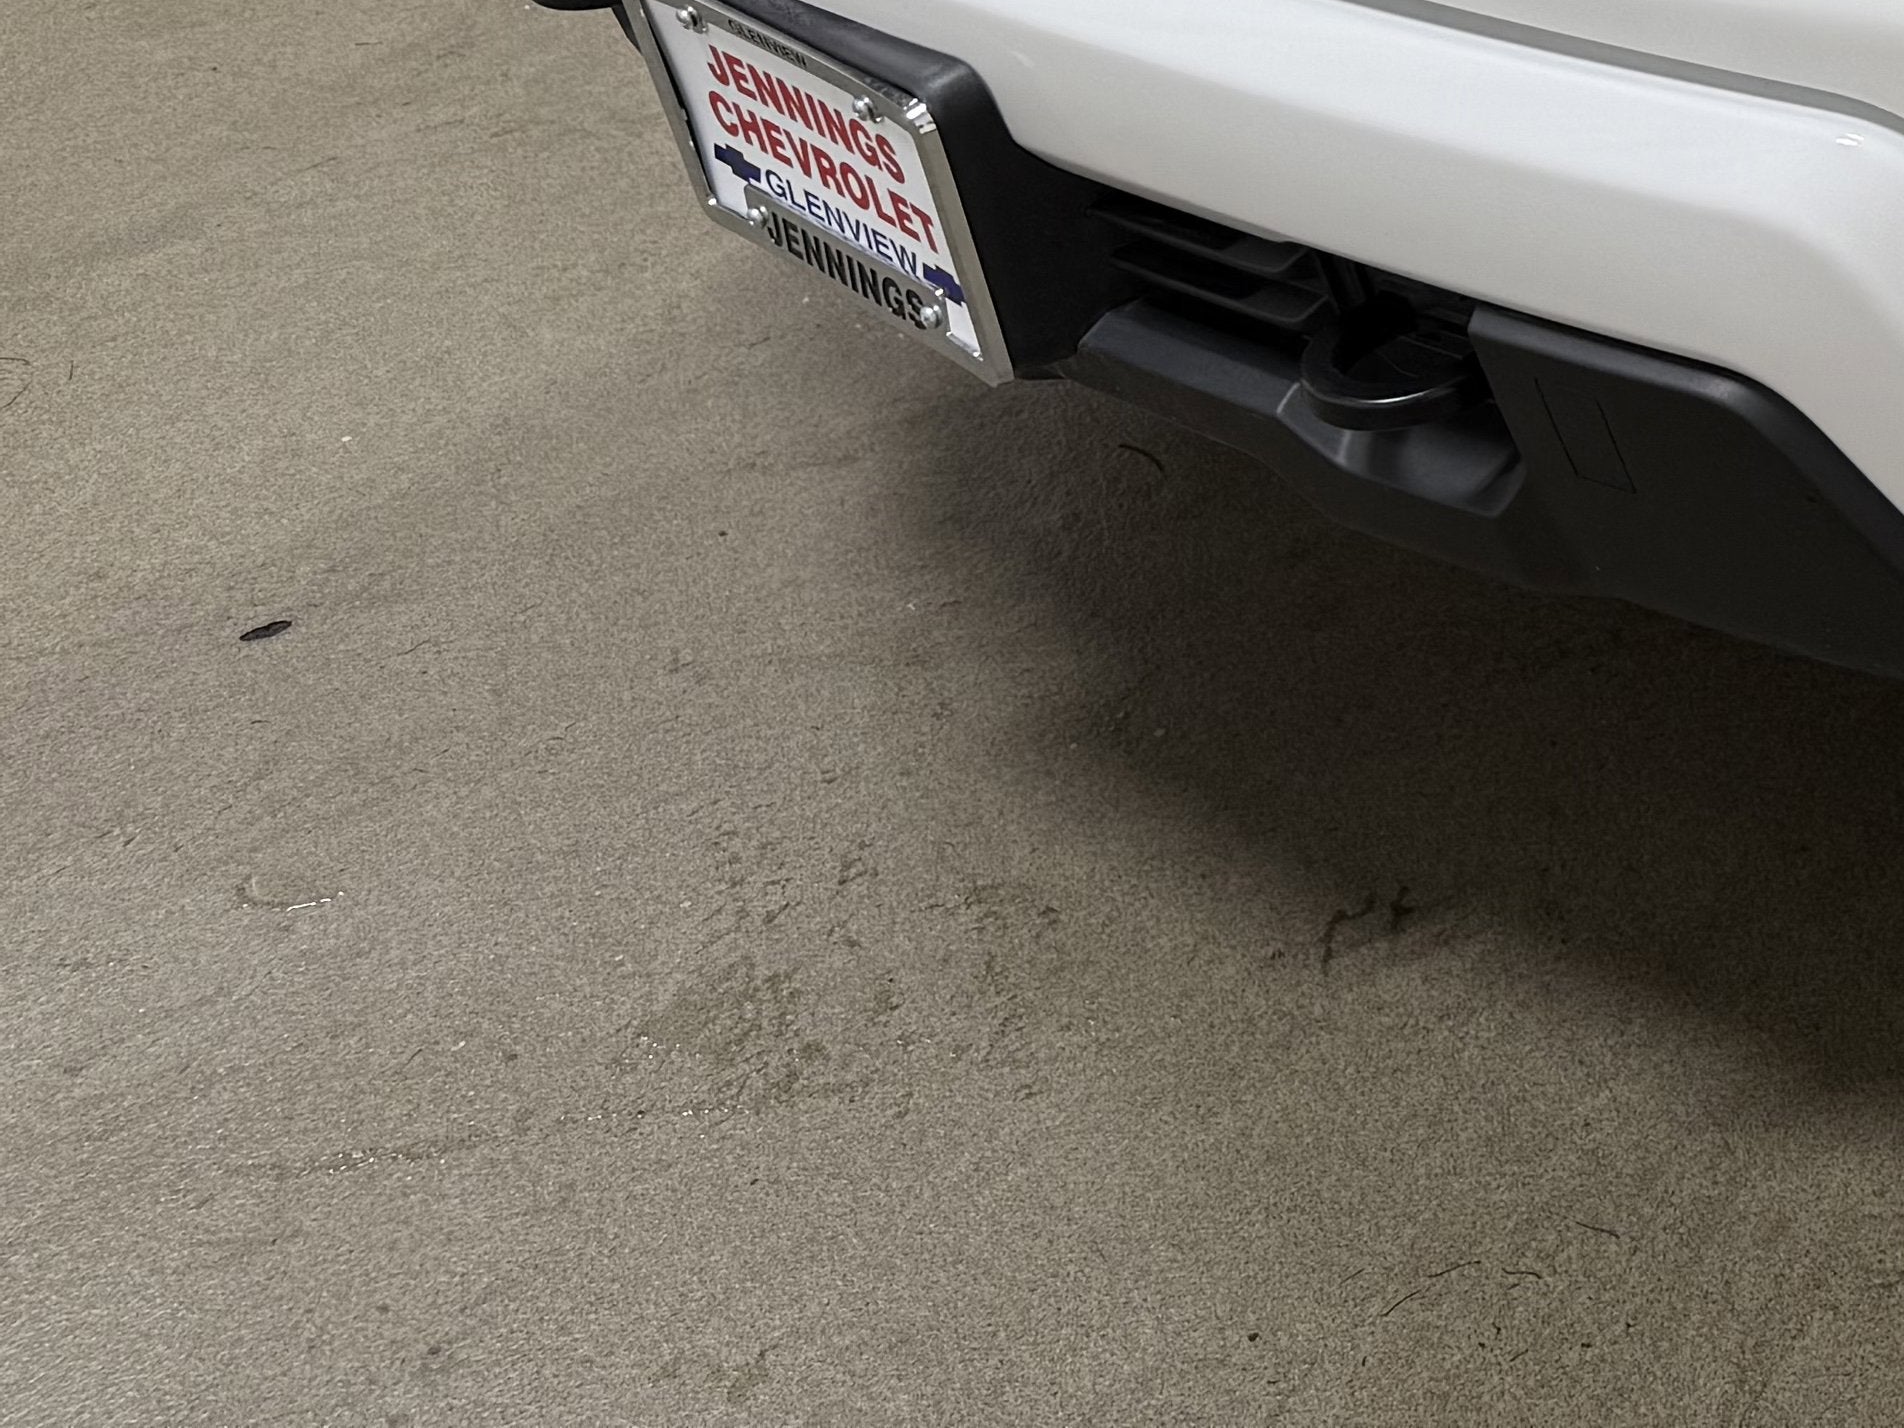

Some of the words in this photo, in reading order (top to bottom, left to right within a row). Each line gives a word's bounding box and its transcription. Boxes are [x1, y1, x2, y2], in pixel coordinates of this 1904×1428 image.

[708, 45, 905, 184] JENNINGS
[708, 91, 938, 253] CHEVROLET
[765, 169, 919, 278] GLENVIEW
[768, 211, 925, 330] JENNINGS
